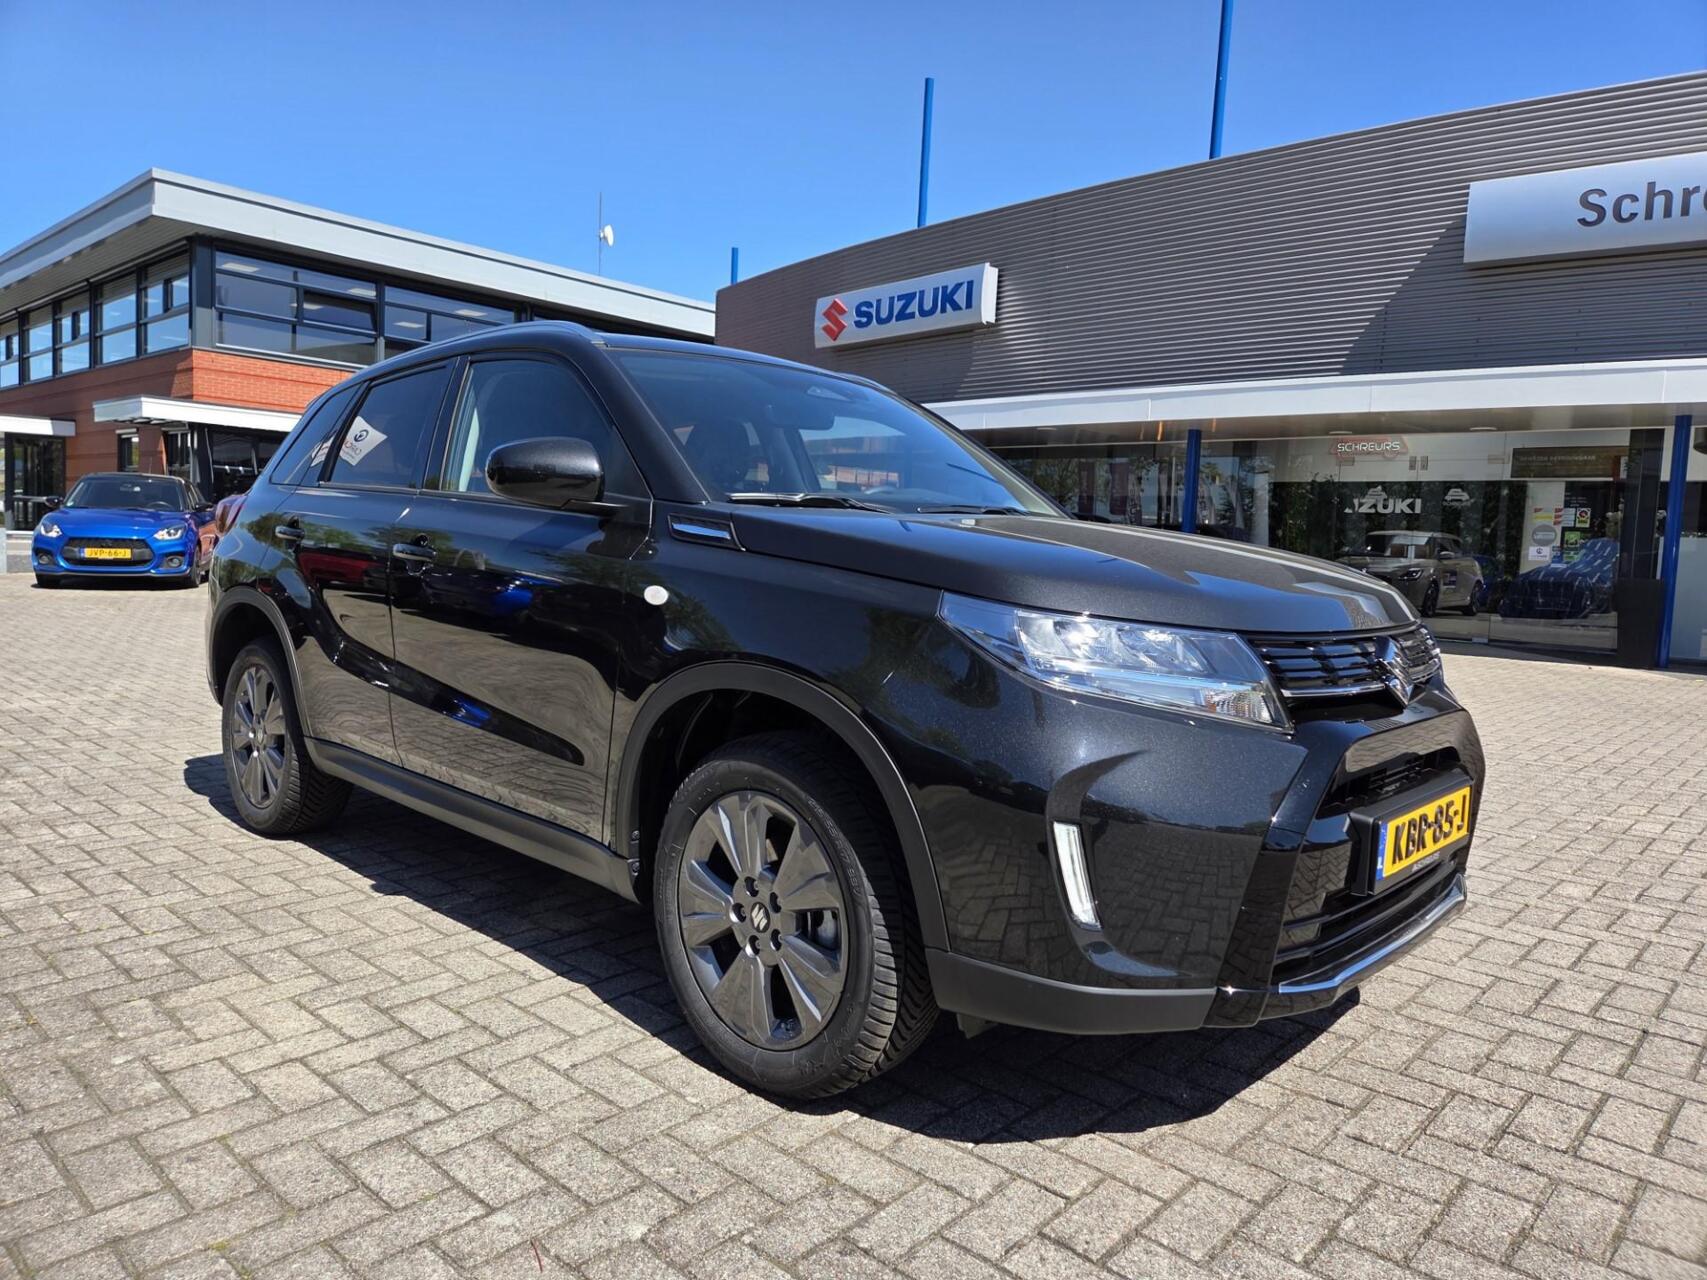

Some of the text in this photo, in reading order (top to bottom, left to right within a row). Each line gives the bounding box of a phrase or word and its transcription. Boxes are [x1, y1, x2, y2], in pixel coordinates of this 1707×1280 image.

[1576, 181, 1707, 228] Schr
[853, 279, 974, 329] SUZUKI
[1337, 441, 1401, 452] SCHREURS
[1392, 794, 1467, 865] KBR-85-J
